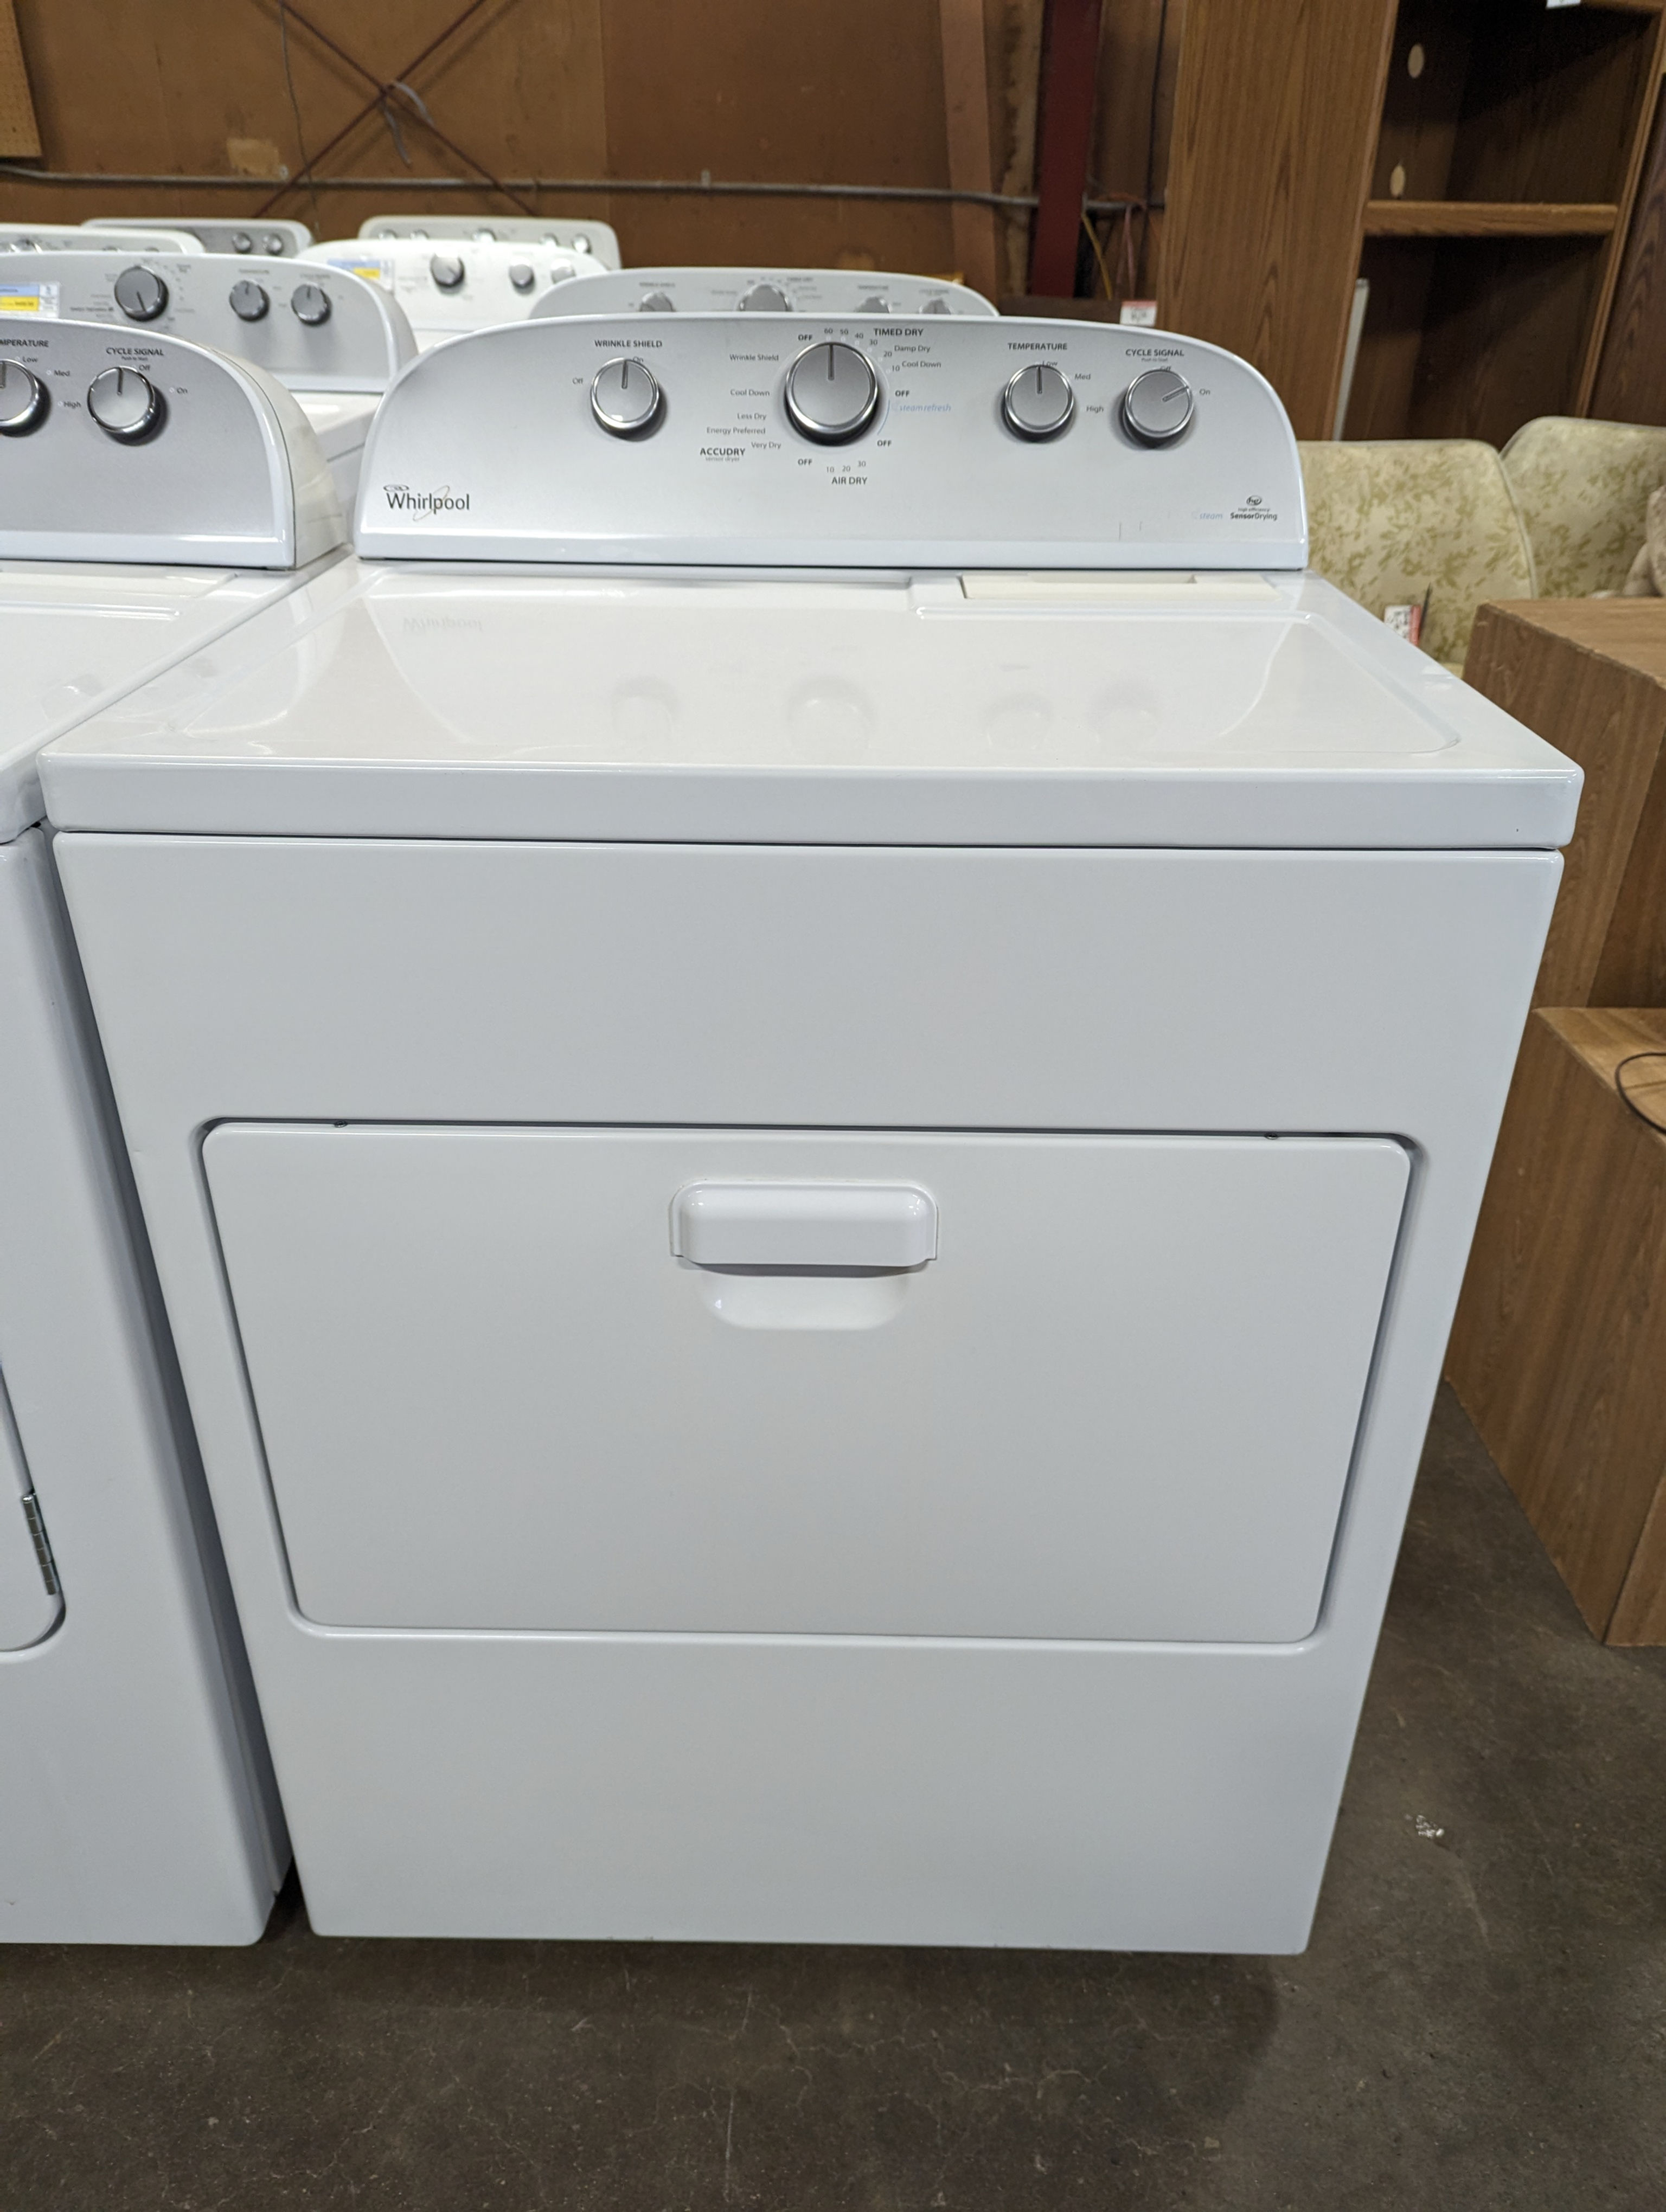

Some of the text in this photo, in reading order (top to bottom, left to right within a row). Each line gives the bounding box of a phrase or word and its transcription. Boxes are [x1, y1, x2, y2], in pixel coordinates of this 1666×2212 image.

[874, 328, 924, 337] TIMED DRY
[594, 339, 663, 348] WRINKLE SHIELD
[106, 347, 164, 356] CYCLE SIGNAL
[918, 345, 931, 353] Dry
[1125, 349, 1184, 357] CYCLE SIGNAL
[700, 448, 746, 456] ACCUDRY
[831, 477, 868, 485] AIR DRY
[386, 492, 470, 515] Whirlpool
